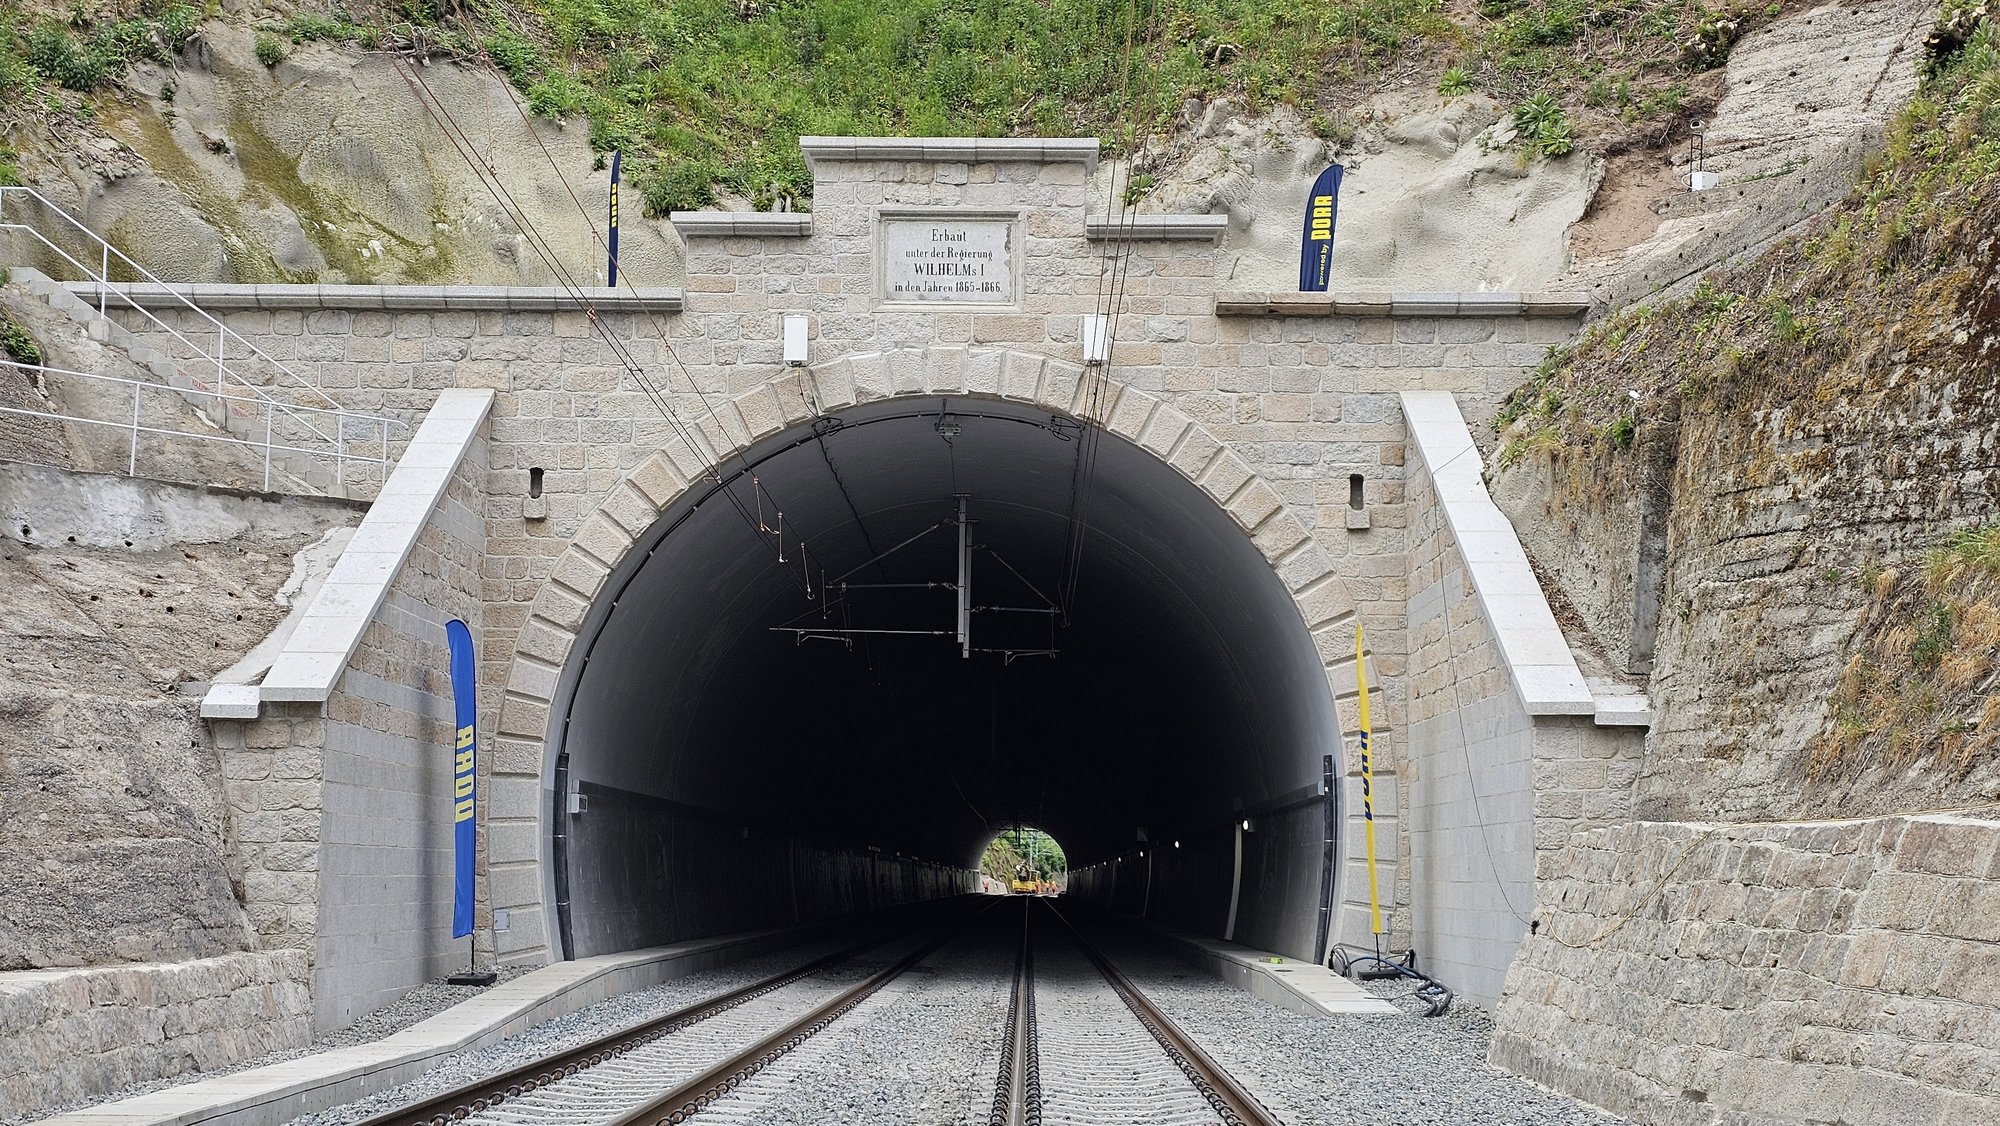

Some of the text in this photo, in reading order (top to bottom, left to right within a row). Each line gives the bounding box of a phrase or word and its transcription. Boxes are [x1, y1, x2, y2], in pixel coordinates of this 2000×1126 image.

[1310, 195, 1332, 240] PORR
[931, 228, 967, 242] Erbaut
[905, 246, 993, 262] unter der Regierung
[980, 263, 985, 276] I
[1318, 243, 1330, 286] powered by
[895, 281, 904, 292] in
[905, 281, 921, 292] den
[922, 280, 953, 293] Jahren
